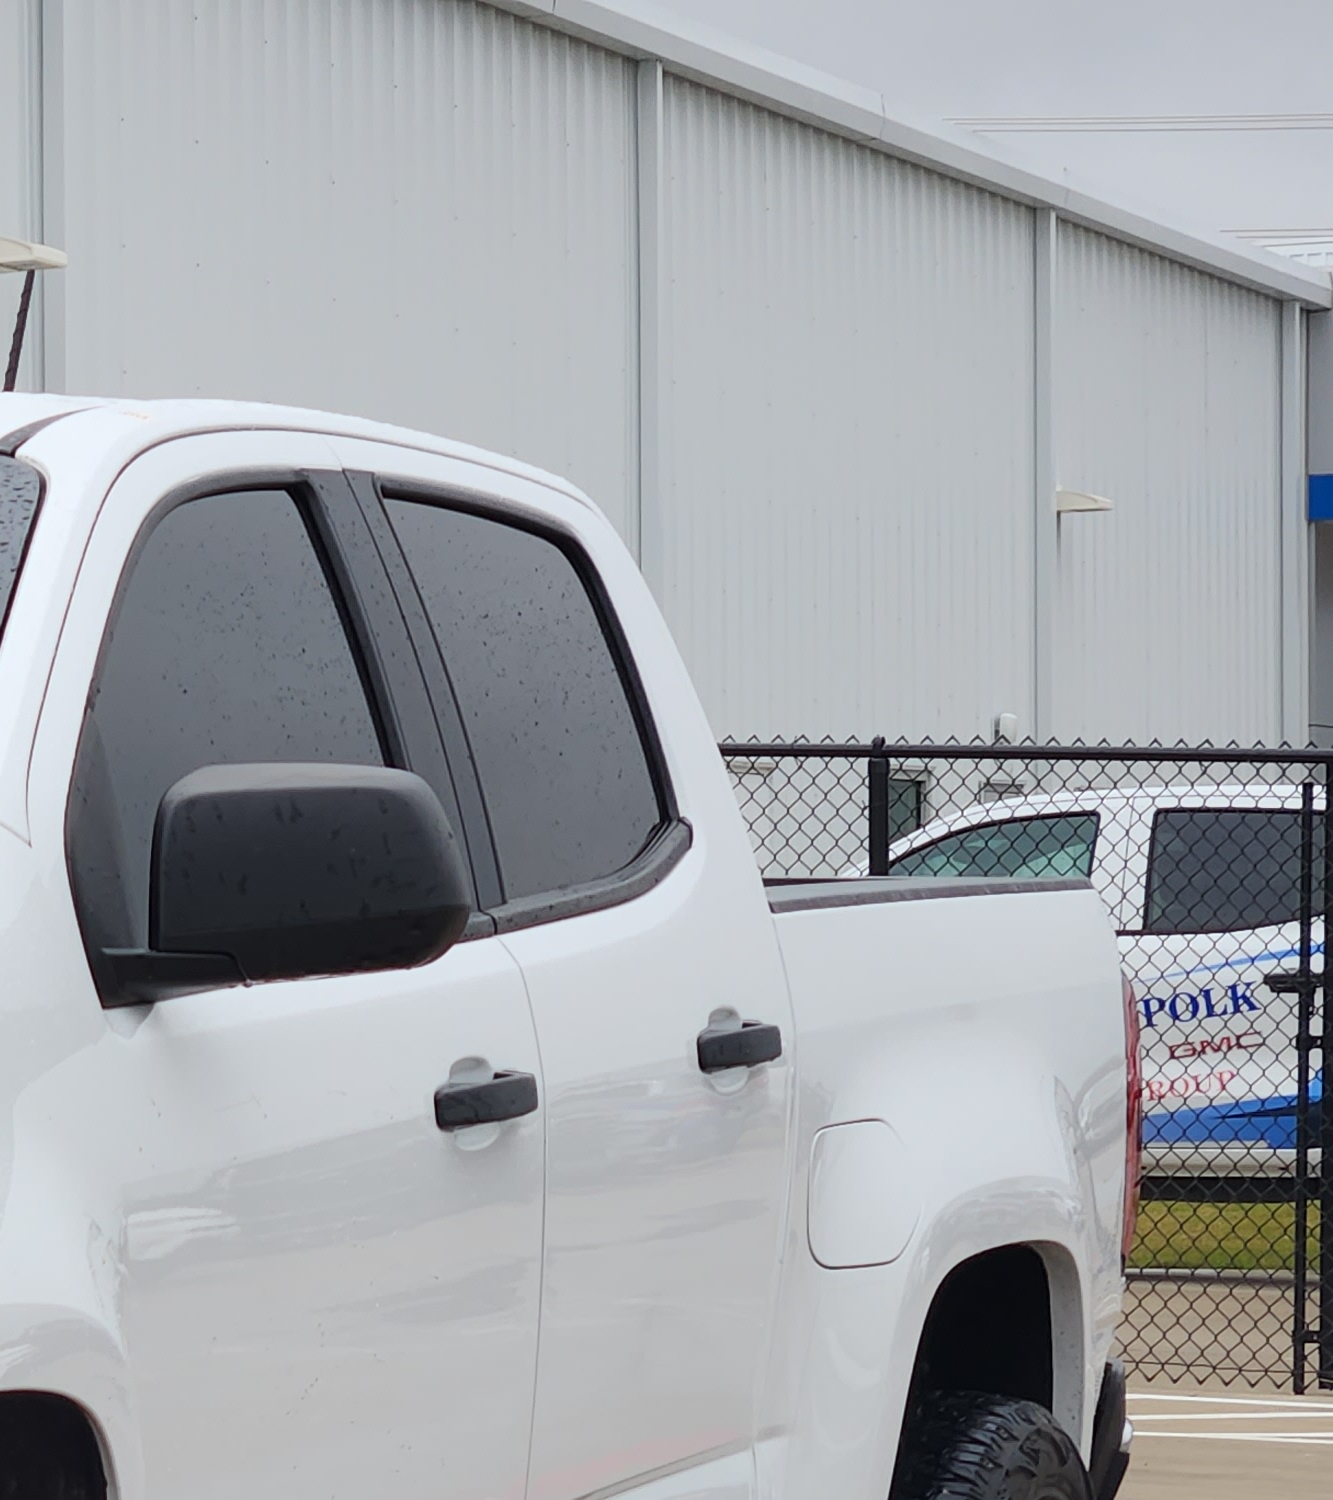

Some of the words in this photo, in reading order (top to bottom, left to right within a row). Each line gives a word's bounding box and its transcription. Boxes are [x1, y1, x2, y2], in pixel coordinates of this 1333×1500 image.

[1141, 981, 1261, 1027] POLK
[1169, 1031, 1264, 1060] GMC
[1146, 1070, 1235, 1101] ROUP
